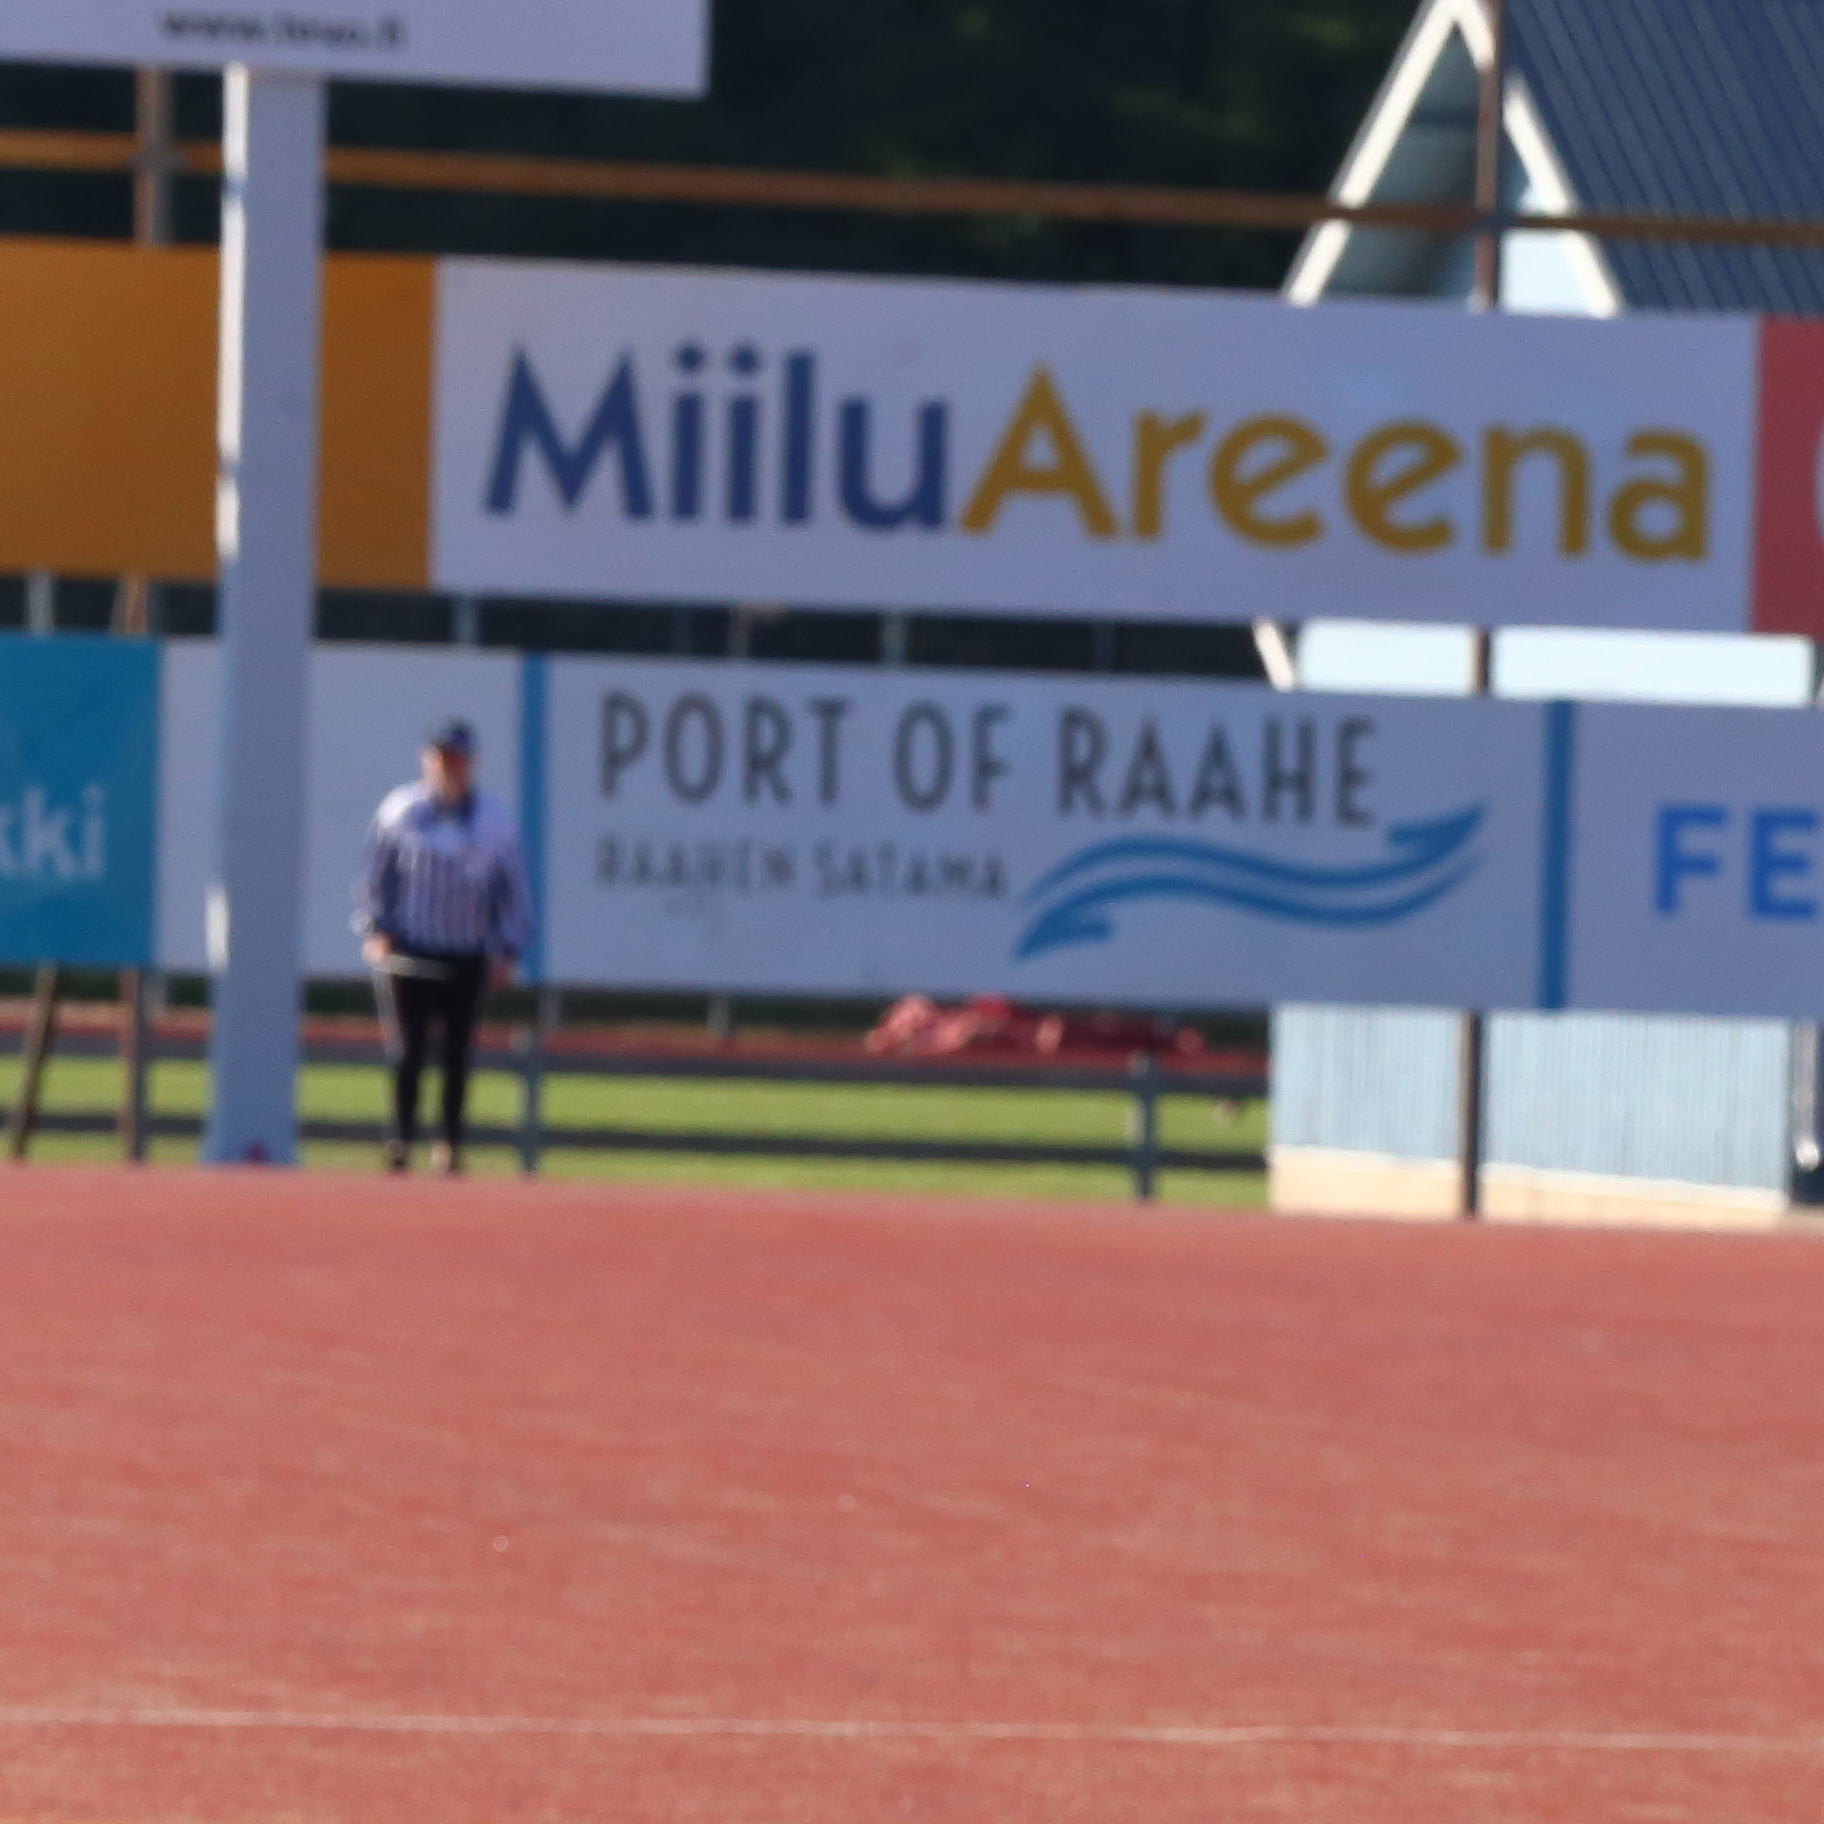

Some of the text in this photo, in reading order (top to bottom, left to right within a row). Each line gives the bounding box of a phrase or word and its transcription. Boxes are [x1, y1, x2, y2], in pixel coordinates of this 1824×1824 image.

[484, 340, 1710, 566] MiiluAreena
[601, 691, 1378, 828] PORT OF RAAHE
[811, 842, 1010, 902] SATAMA
